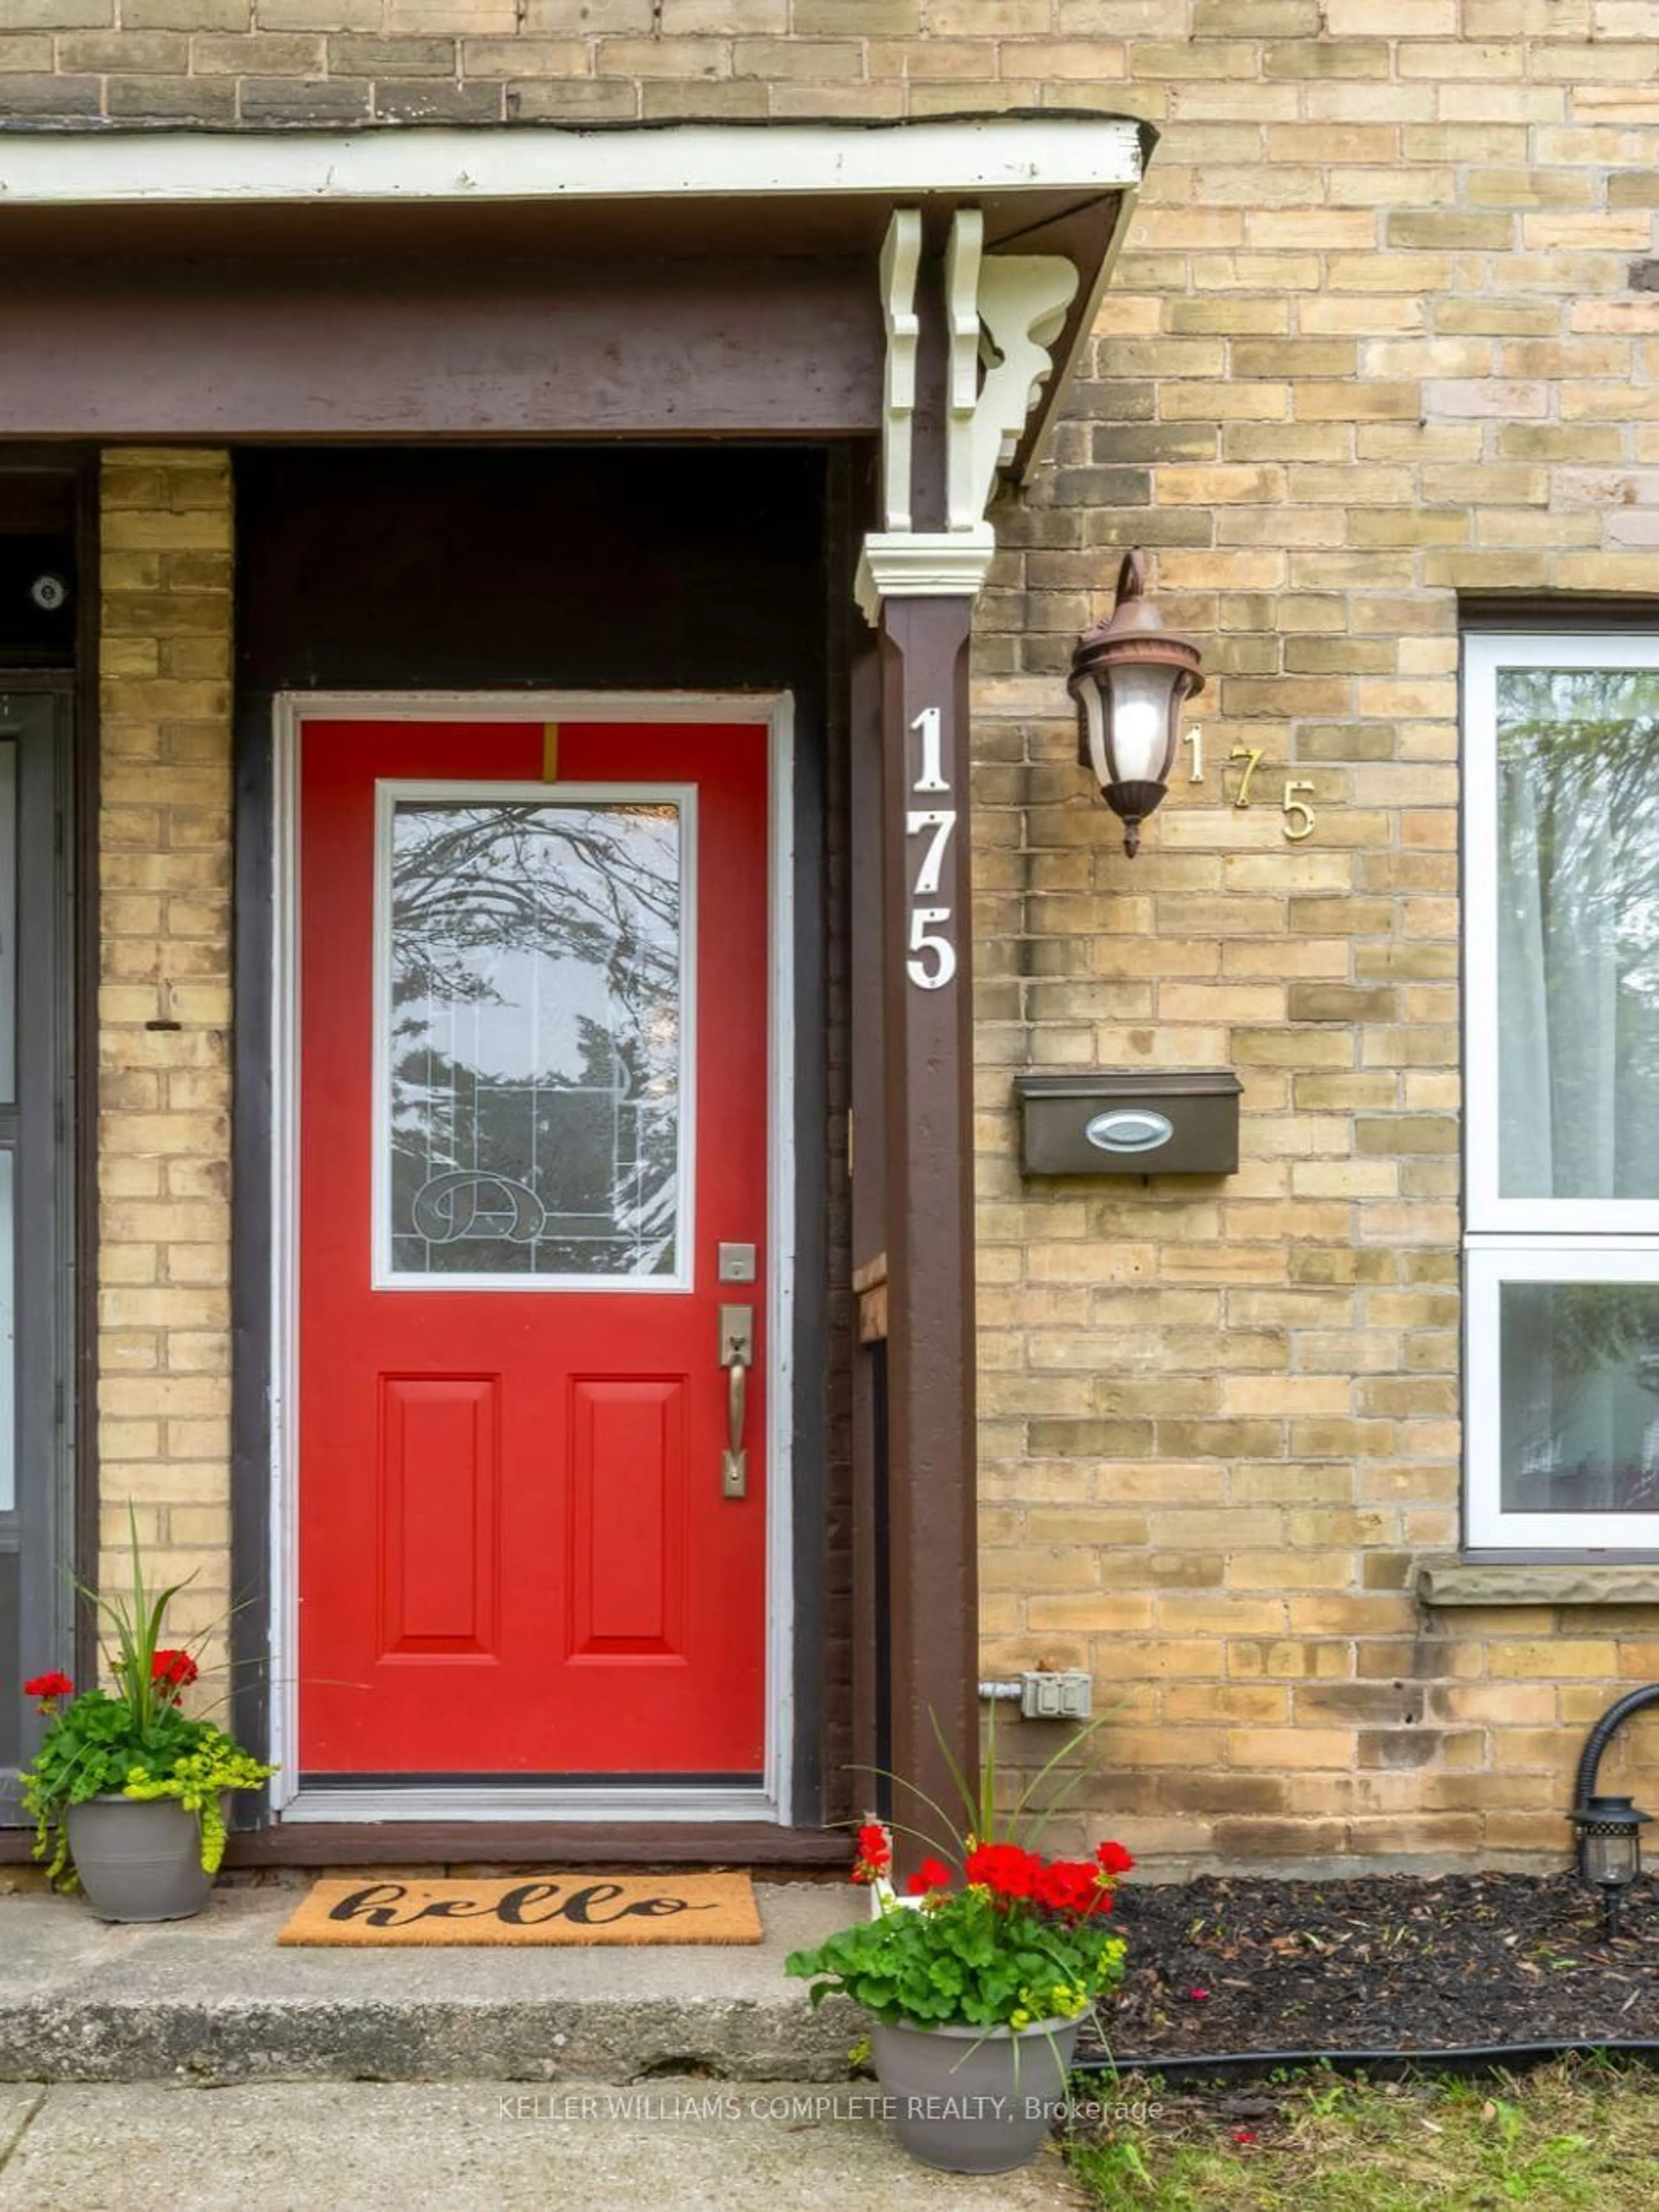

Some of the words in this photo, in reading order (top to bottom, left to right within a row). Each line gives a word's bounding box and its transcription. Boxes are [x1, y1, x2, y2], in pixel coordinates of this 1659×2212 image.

[1184, 724, 1315, 839] 175
[906, 707, 957, 990] 175
[328, 1884, 718, 1926] hello
